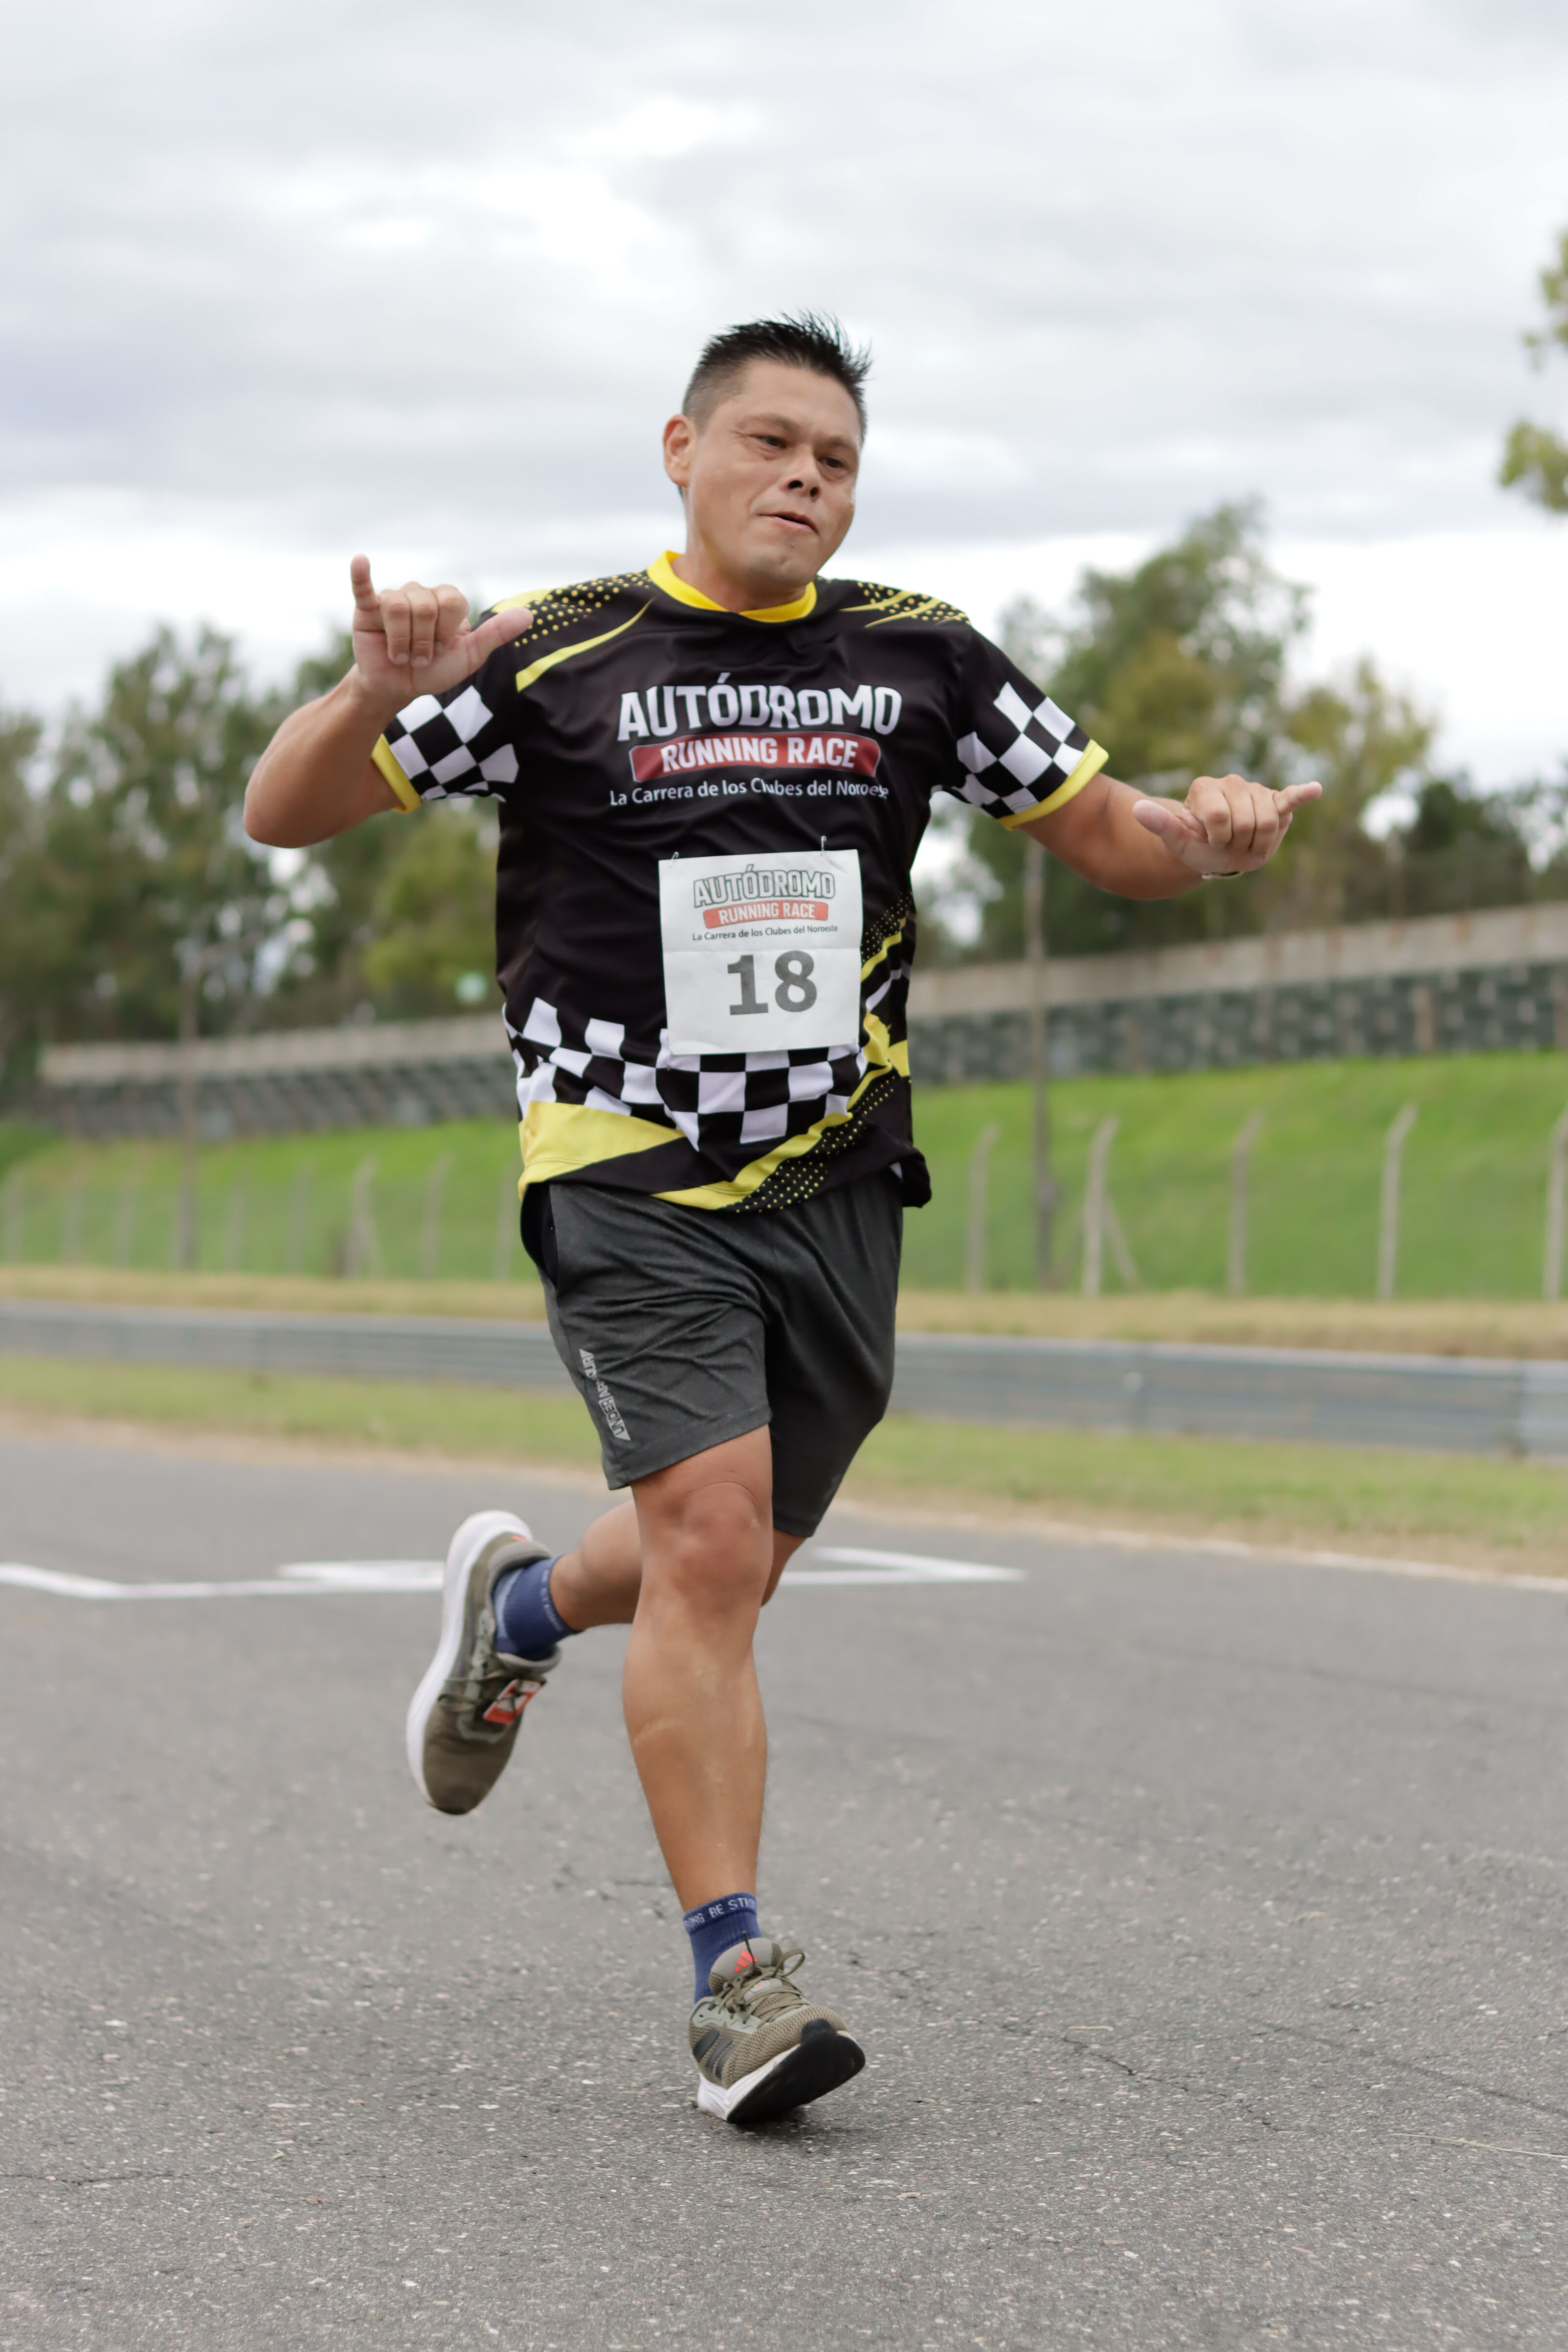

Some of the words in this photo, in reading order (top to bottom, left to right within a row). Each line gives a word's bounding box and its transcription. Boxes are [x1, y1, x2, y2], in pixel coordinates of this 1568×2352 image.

[617, 672, 902, 741] AUTÓDROMO
[660, 737, 777, 772] RUNNING
[787, 737, 858, 768] RACE
[610, 790, 627, 806] La
[632, 784, 693, 804] Carrera
[698, 781, 718, 797] de
[722, 780, 746, 795] los
[751, 778, 803, 796] Clubes
[808, 781, 832, 795] del
[693, 864, 835, 908] AUTÓDROMO
[704, 931, 735, 940] Carrera
[738, 929, 749, 937] de
[765, 927, 792, 936] Clubes
[793, 925, 805, 934] del
[807, 924, 838, 933] Noroeste
[718, 903, 779, 925] RUNNING
[783, 902, 815, 918] RACE
[727, 950, 817, 1015] 18
[582, 1352, 612, 1399] AROUR
[599, 1396, 627, 1438] UNDER
[709, 1904, 724, 1918] BE
